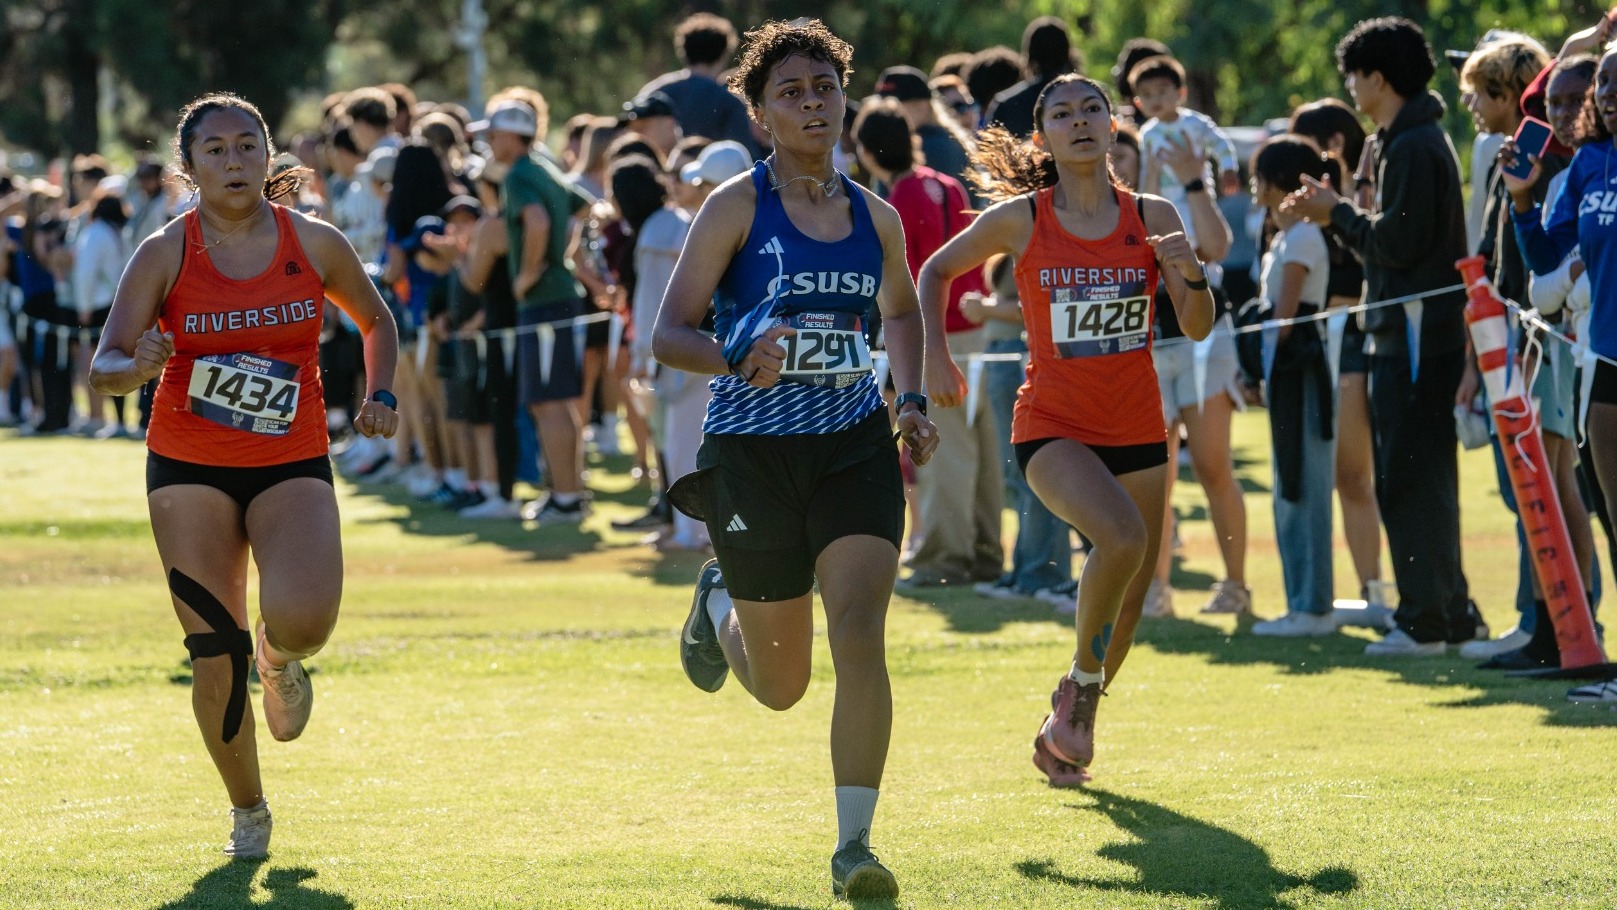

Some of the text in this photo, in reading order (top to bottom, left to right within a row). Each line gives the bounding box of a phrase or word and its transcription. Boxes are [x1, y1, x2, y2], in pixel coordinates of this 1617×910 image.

[1597, 213, 1615, 226] TF
[767, 272, 876, 297] CSUSB
[1040, 268, 1146, 286] RIVERSIDE
[184, 299, 317, 333] RIVERSIDE
[804, 321, 834, 329] RESULTS
[1064, 299, 1148, 338] 1428
[241, 355, 272, 367] FINISHED
[783, 332, 861, 371] 1291
[238, 363, 269, 374] RESULTS
[203, 365, 298, 419] 1434
